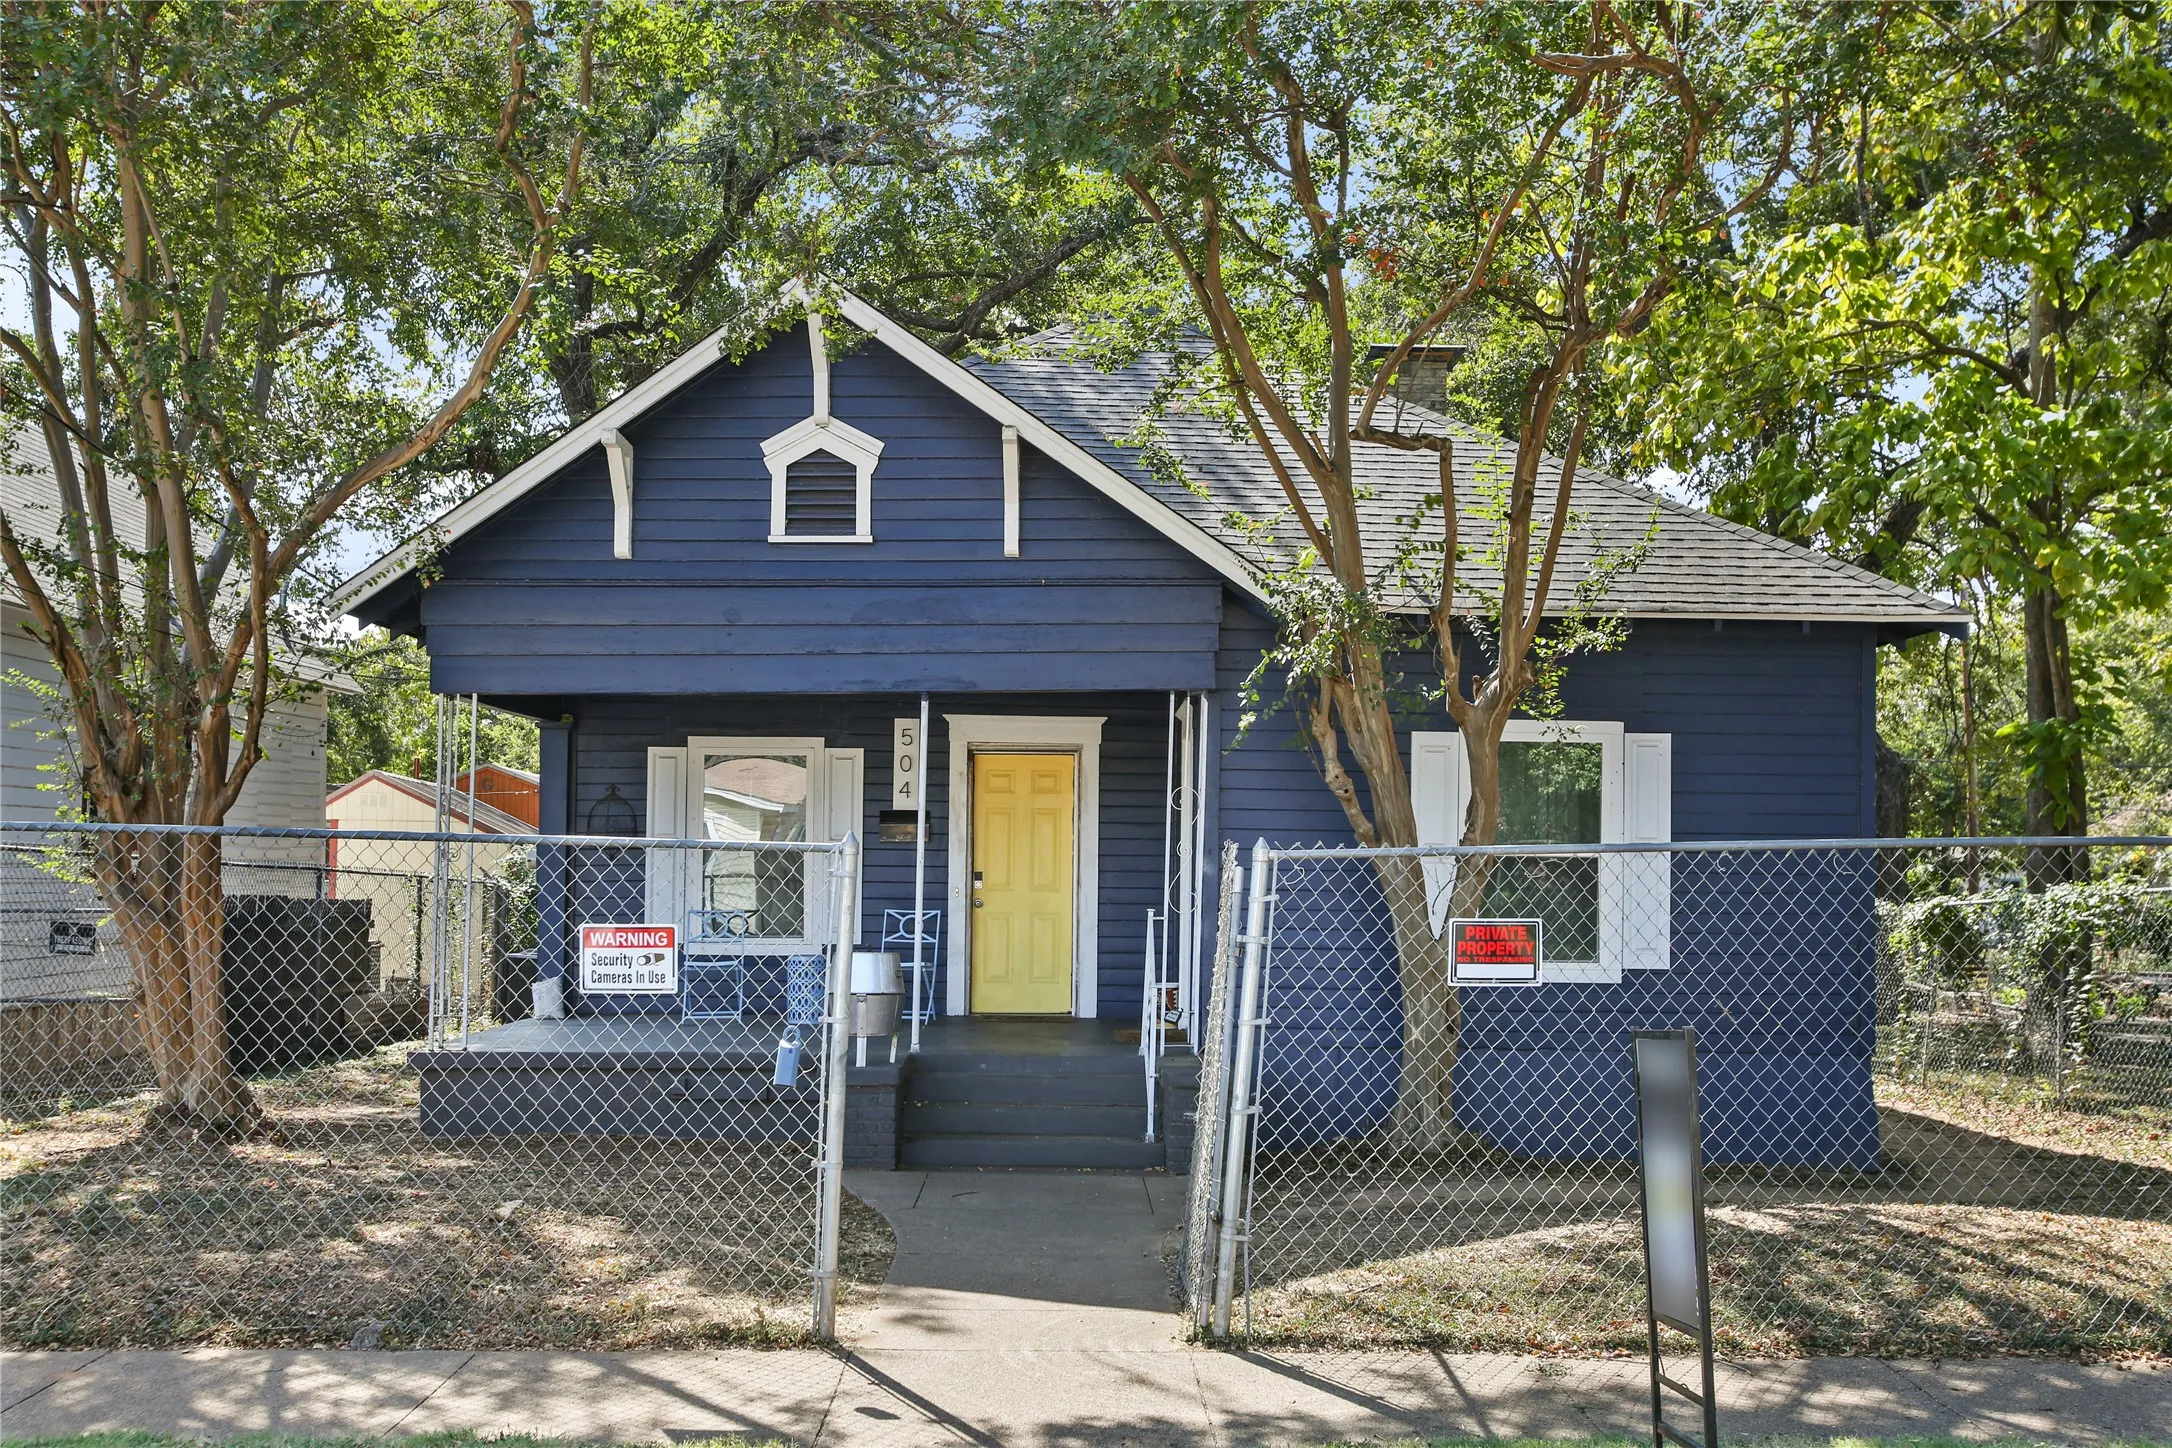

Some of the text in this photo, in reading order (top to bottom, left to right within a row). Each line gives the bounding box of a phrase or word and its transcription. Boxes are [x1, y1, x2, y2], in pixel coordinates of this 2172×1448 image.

[899, 728, 913, 799] 504
[590, 932, 667, 946] WARNING
[1465, 926, 1527, 940] PRIVATE
[1457, 941, 1535, 955] PROPERTY
[591, 952, 633, 969] Security
[591, 970, 633, 984] Cameras
[636, 970, 645, 984] In
[648, 970, 666, 984] Use
